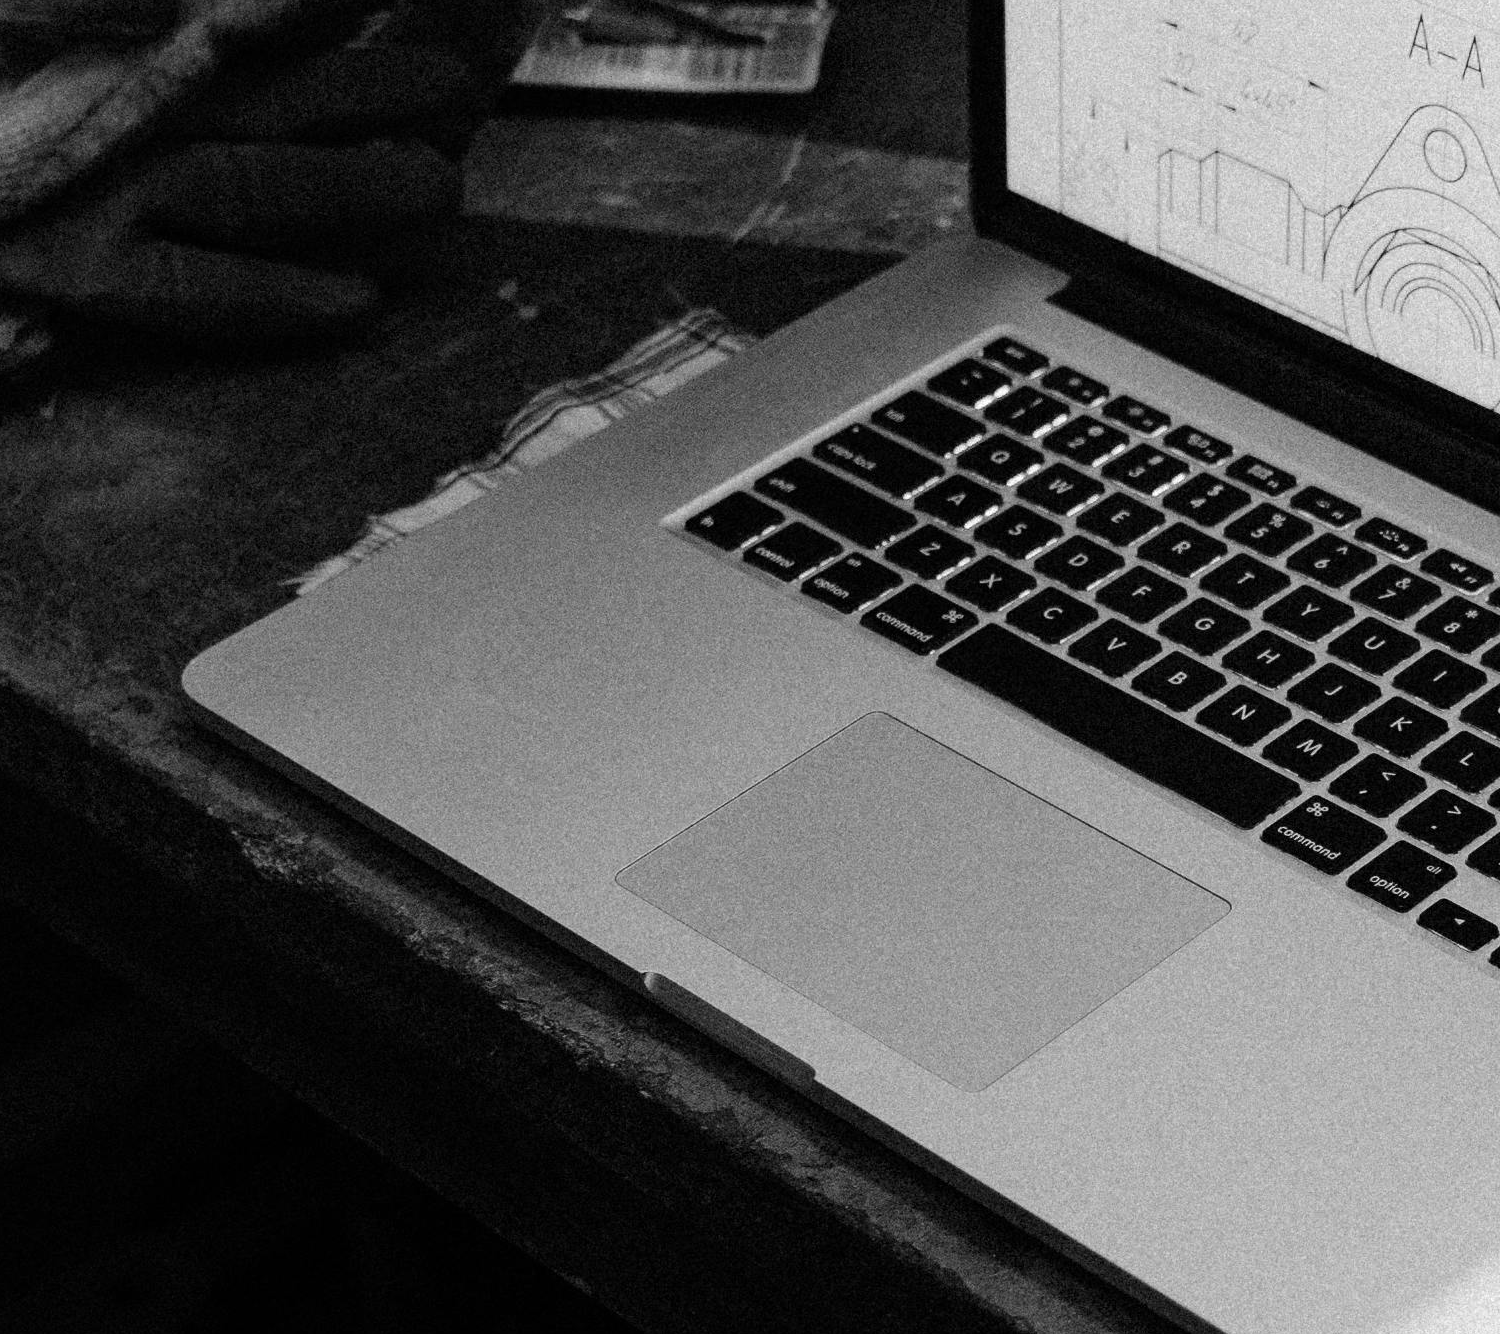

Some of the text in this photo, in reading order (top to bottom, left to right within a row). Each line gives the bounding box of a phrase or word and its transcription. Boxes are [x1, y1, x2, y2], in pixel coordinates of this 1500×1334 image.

[1049, 479, 1073, 494] W
[947, 493, 966, 505] A
[1111, 510, 1130, 523] E
[1008, 523, 1026, 535] S
[1251, 527, 1268, 538] 5
[920, 542, 941, 556] Z
[1172, 541, 1191, 554] R
[753, 546, 795, 569] control
[1068, 553, 1088, 567] D
[1314, 559, 1329, 568] 6
[980, 574, 1001, 588] X
[1238, 572, 1255, 584] T
[812, 577, 850, 600] option
[1132, 585, 1151, 596] F
[1379, 589, 1396, 599] 7
[1043, 607, 1063, 619] C
[1302, 604, 1319, 616] Y
[875, 611, 933, 644] command
[1195, 618, 1215, 631] G
[1444, 622, 1460, 633] 8
[1107, 637, 1126, 650] V
[1364, 636, 1385, 650] U
[1257, 649, 1280, 664] H
[1168, 671, 1187, 685] B
[1325, 685, 1343, 696] J
[1232, 704, 1255, 720] N
[1390, 717, 1412, 731] K
[1297, 739, 1322, 756] M
[1460, 752, 1473, 766] L
[1276, 825, 1341, 861] command
[1368, 873, 1412, 901] option
